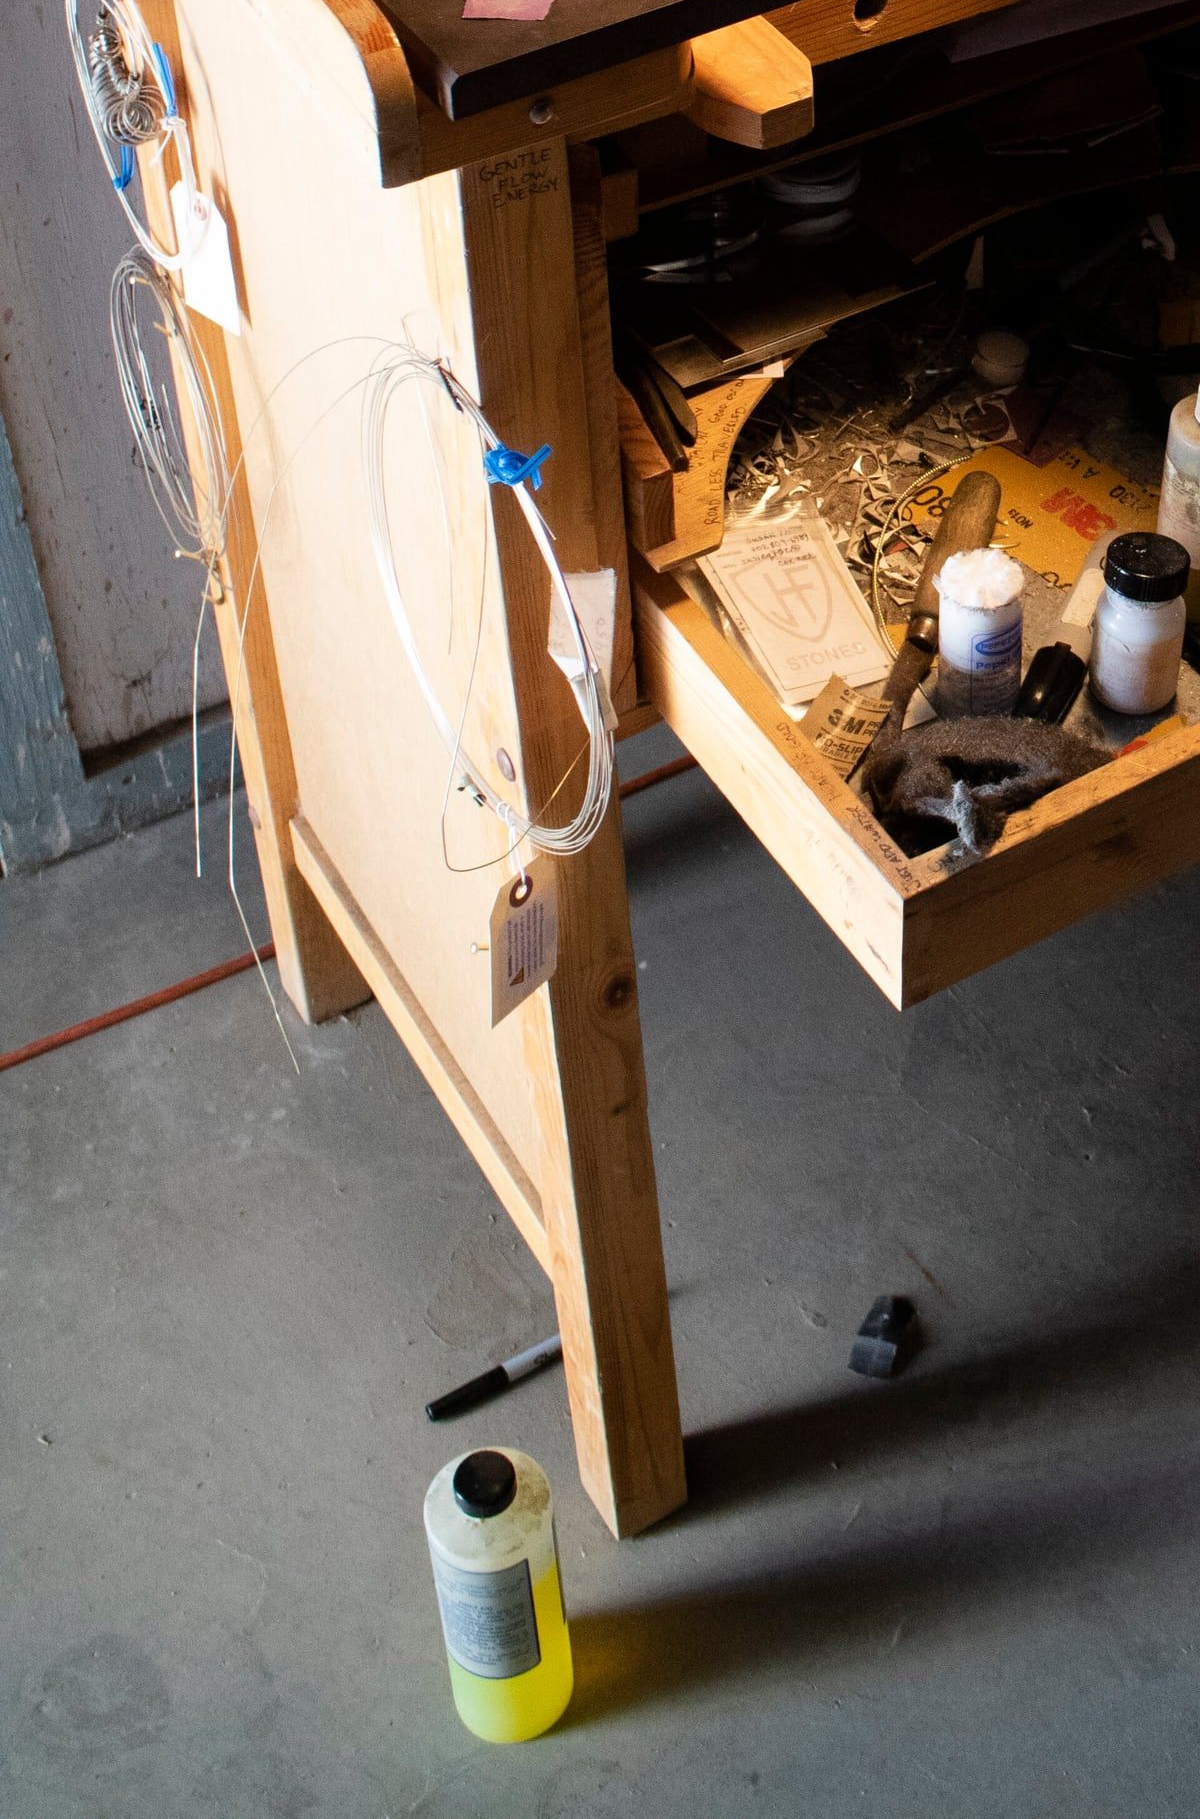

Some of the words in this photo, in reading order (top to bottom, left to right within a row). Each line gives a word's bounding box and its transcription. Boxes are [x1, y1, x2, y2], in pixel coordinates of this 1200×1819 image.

[479, 148, 552, 183] GENTLE
[497, 168, 548, 194] FLOW
[493, 177, 560, 210] ENERGY
[709, 467, 723, 495] LESS
[704, 499, 722, 527] ROAD
[1040, 487, 1118, 541] 3M
[785, 641, 867, 672] STONES
